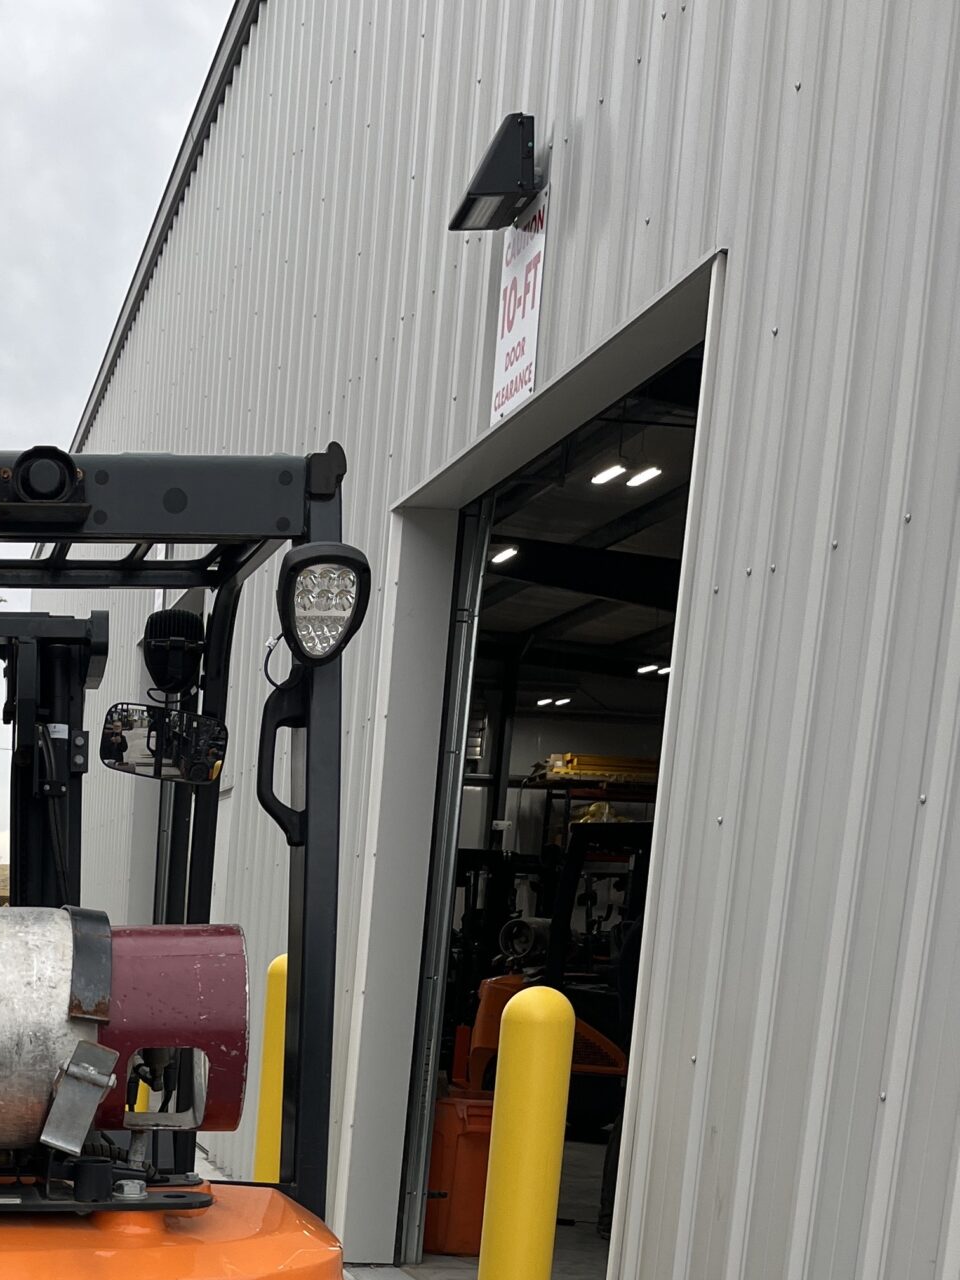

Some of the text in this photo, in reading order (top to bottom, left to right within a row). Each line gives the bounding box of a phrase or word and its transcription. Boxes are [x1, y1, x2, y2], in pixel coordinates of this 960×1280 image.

[500, 251, 541, 340] 10-FT
[505, 336, 526, 372] DOOR
[494, 362, 533, 412] CLEARANCE
